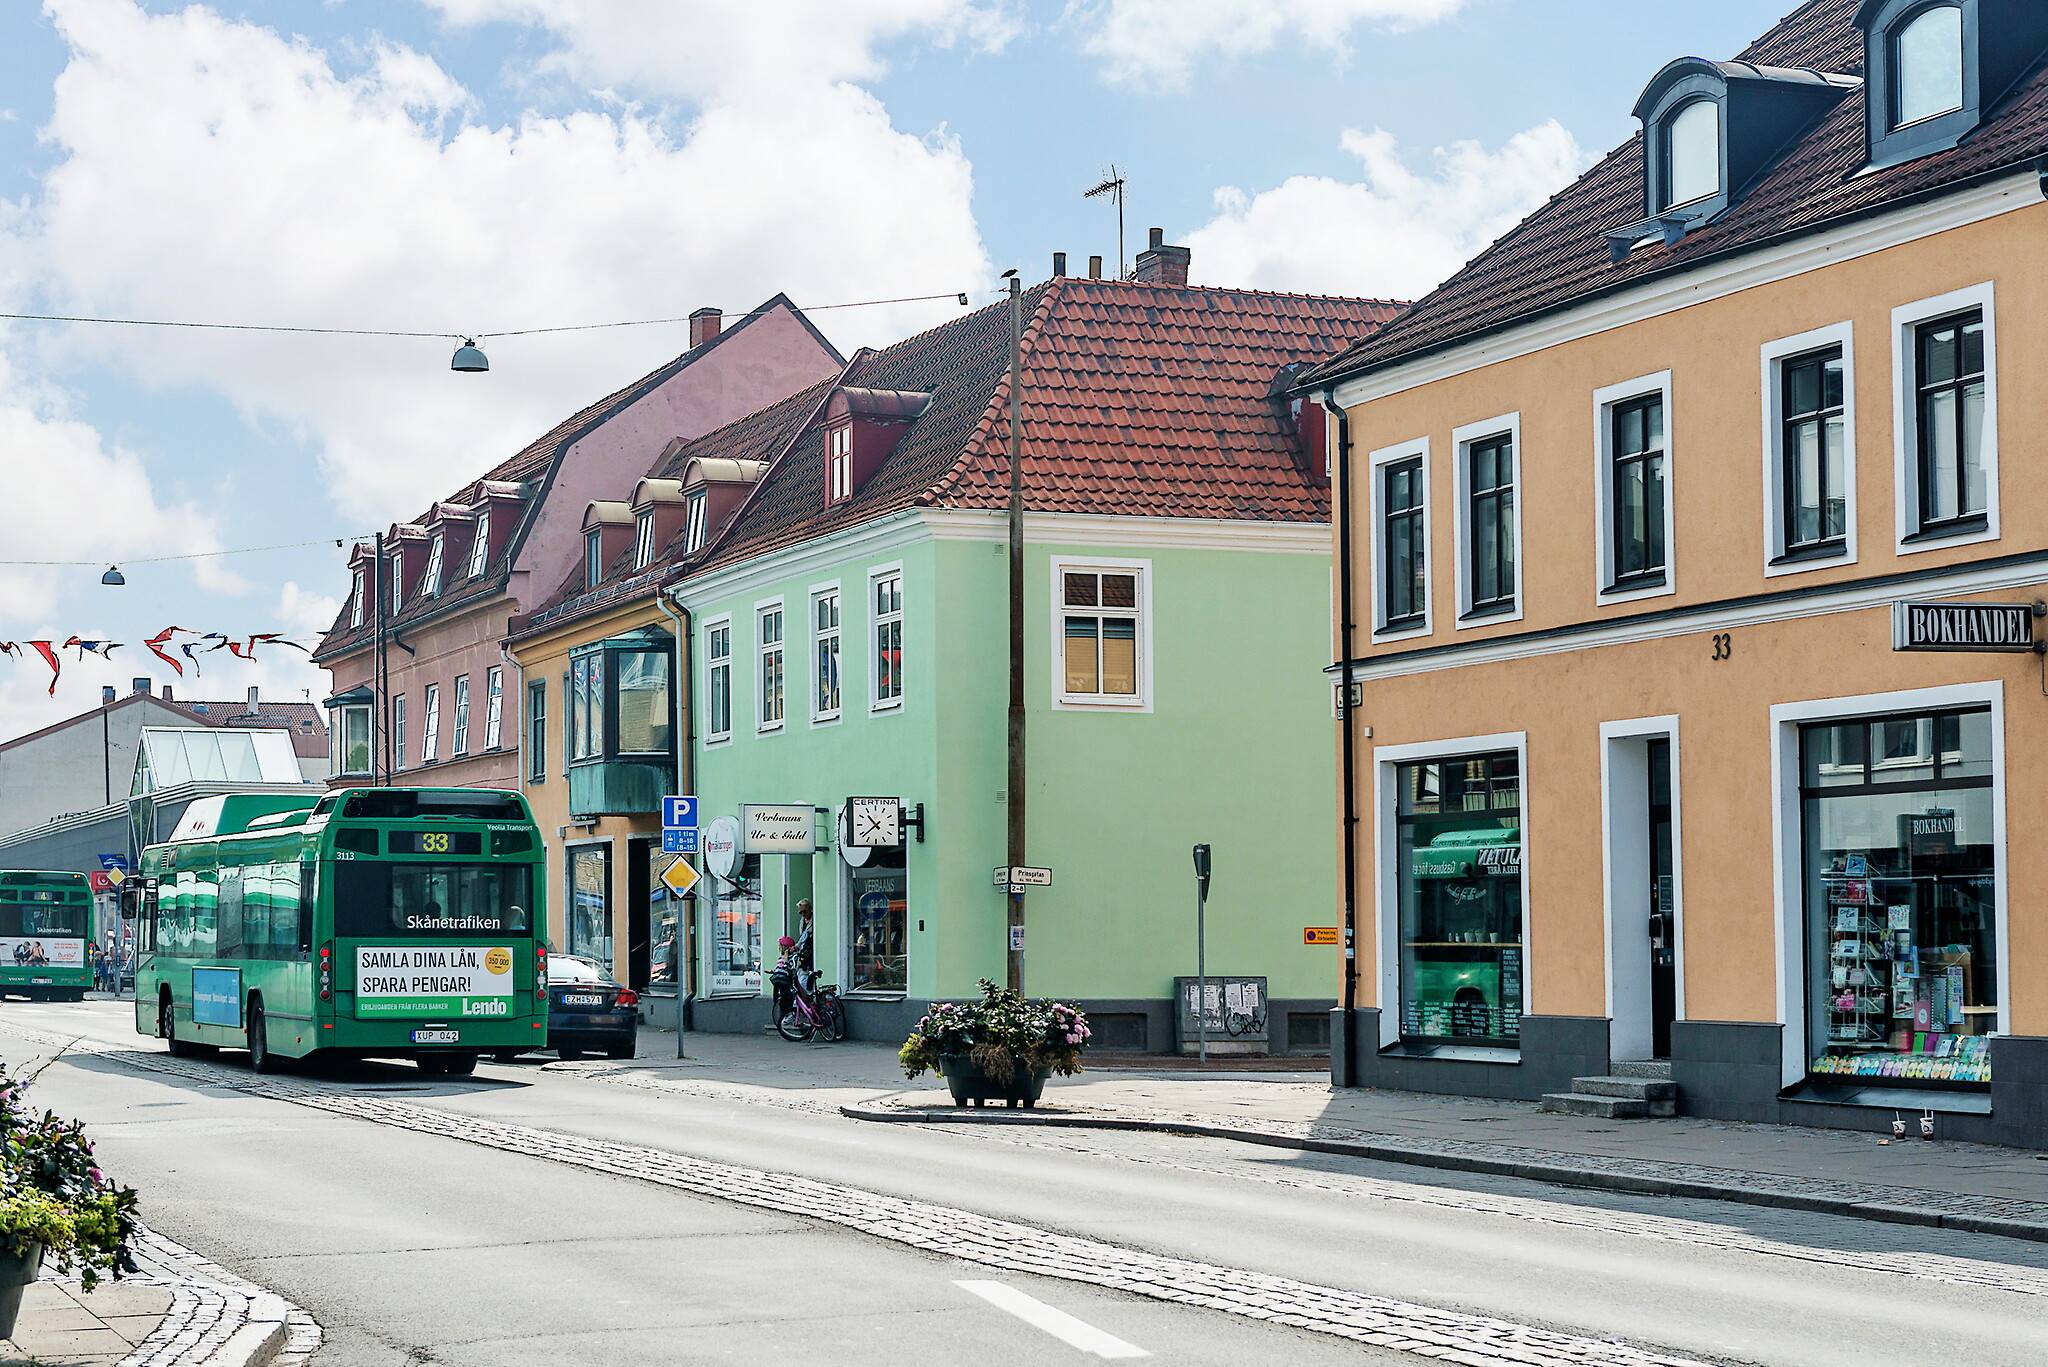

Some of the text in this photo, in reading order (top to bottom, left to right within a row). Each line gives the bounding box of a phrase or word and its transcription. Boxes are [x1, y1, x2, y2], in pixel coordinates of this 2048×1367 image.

[1911, 608, 2031, 644] BOKHANDEL
[1711, 632, 1732, 661] 33
[673, 799, 691, 825] P
[755, 812, 803, 823] Verbaans
[487, 823, 533, 832] Veolia Transport
[1913, 816, 1965, 835] BOKHANDEL
[422, 833, 449, 852] 33
[750, 830, 766, 840] Ur
[769, 831, 779, 840] &
[336, 851, 355, 861] 3113
[407, 914, 501, 930] Skånetrafiken
[361, 948, 480, 970] SAMLA DINA LÅN,
[488, 957, 510, 966] 350 000
[362, 976, 471, 993] SPARA PENGAR!
[462, 998, 507, 1015] Lendo
[416, 1031, 457, 1040] XUP 042
